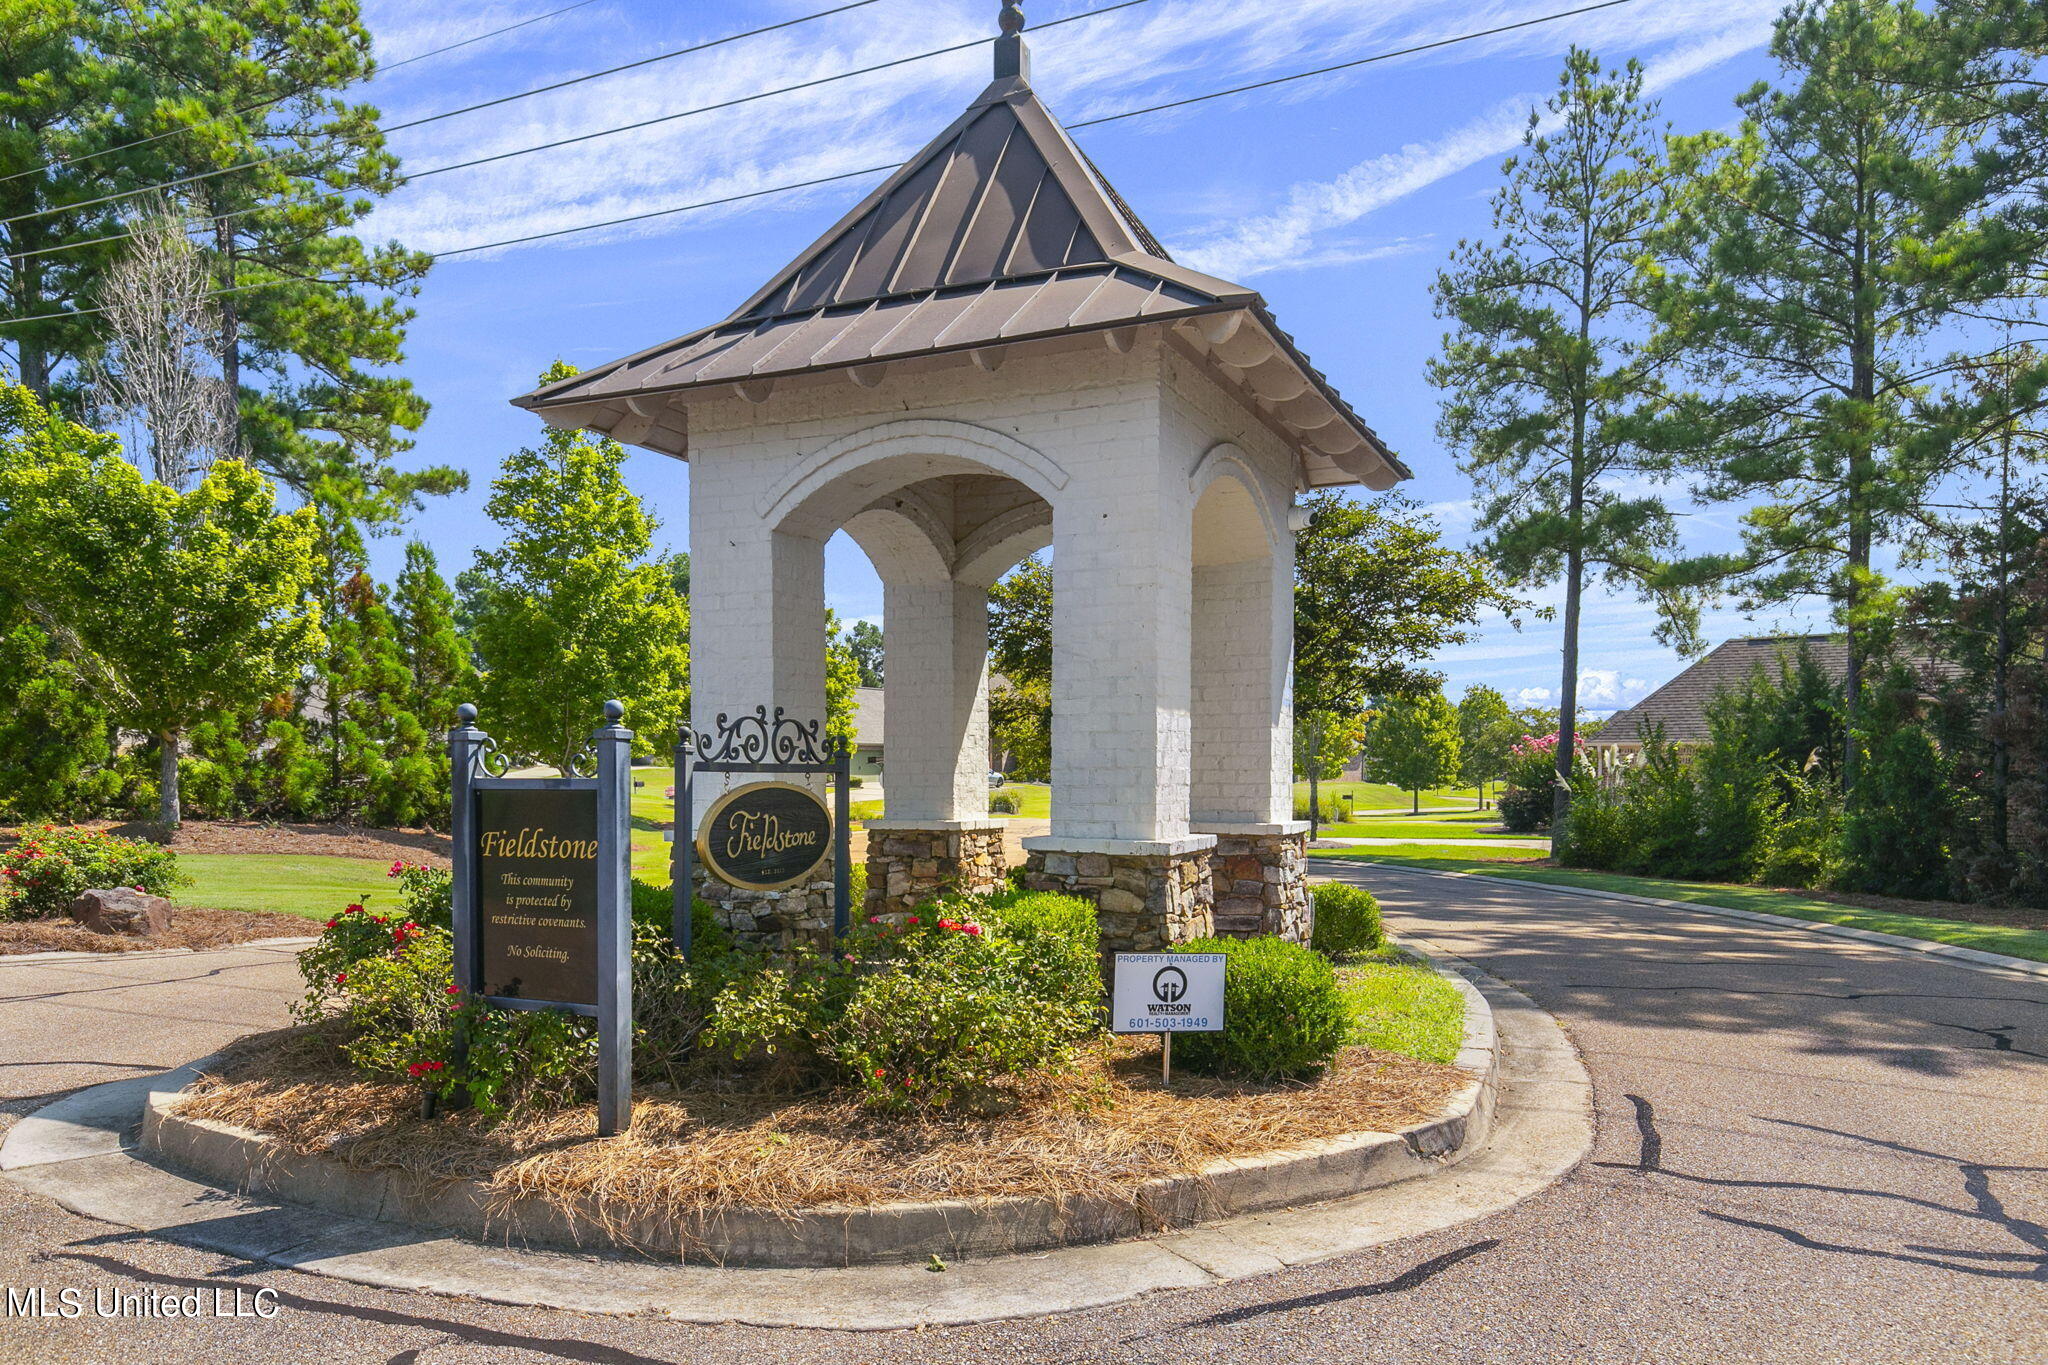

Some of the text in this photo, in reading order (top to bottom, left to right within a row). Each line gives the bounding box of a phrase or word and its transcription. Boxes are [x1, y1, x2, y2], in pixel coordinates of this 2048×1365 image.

[727, 810, 817, 859] Fieldstone
[481, 828, 598, 859] Fieldstone
[501, 872, 574, 890] This community
[506, 894, 572, 910] is protected by
[491, 914, 587, 929] restrictive covenants.
[507, 945, 570, 963] No Soliciting.
[1117, 955, 1224, 963] PROPERTY MANAGED BY
[1147, 1004, 1191, 1012] WATSON
[1129, 1017, 1208, 1028] 601-503-1949
